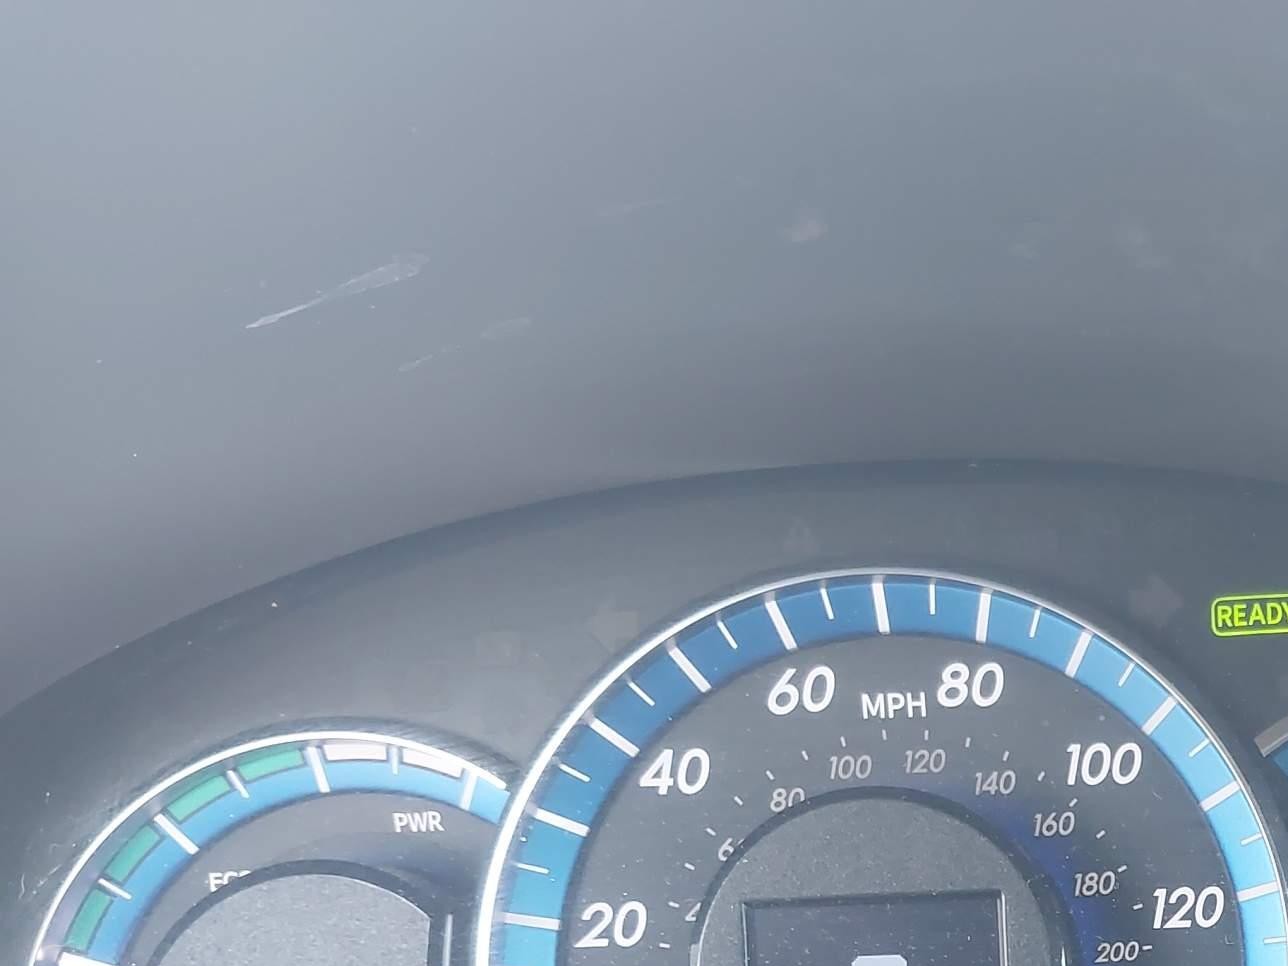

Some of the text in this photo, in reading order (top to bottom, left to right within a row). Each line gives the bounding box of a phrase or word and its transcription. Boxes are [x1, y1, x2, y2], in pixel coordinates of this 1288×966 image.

[767, 665, 836, 715] 60
[936, 662, 1004, 708] 80
[860, 691, 928, 720] MPH
[639, 749, 711, 795] 40
[828, 754, 873, 781] 100
[904, 748, 947, 774] 120
[1066, 742, 1143, 786] 100
[974, 770, 1017, 796] 140
[392, 811, 445, 833] PWR
[1033, 810, 1076, 837] 160
[1074, 870, 1117, 897] 180
[1152, 886, 1226, 931] 120
[573, 900, 648, 948] 20
[1095, 941, 1140, 964] 200
